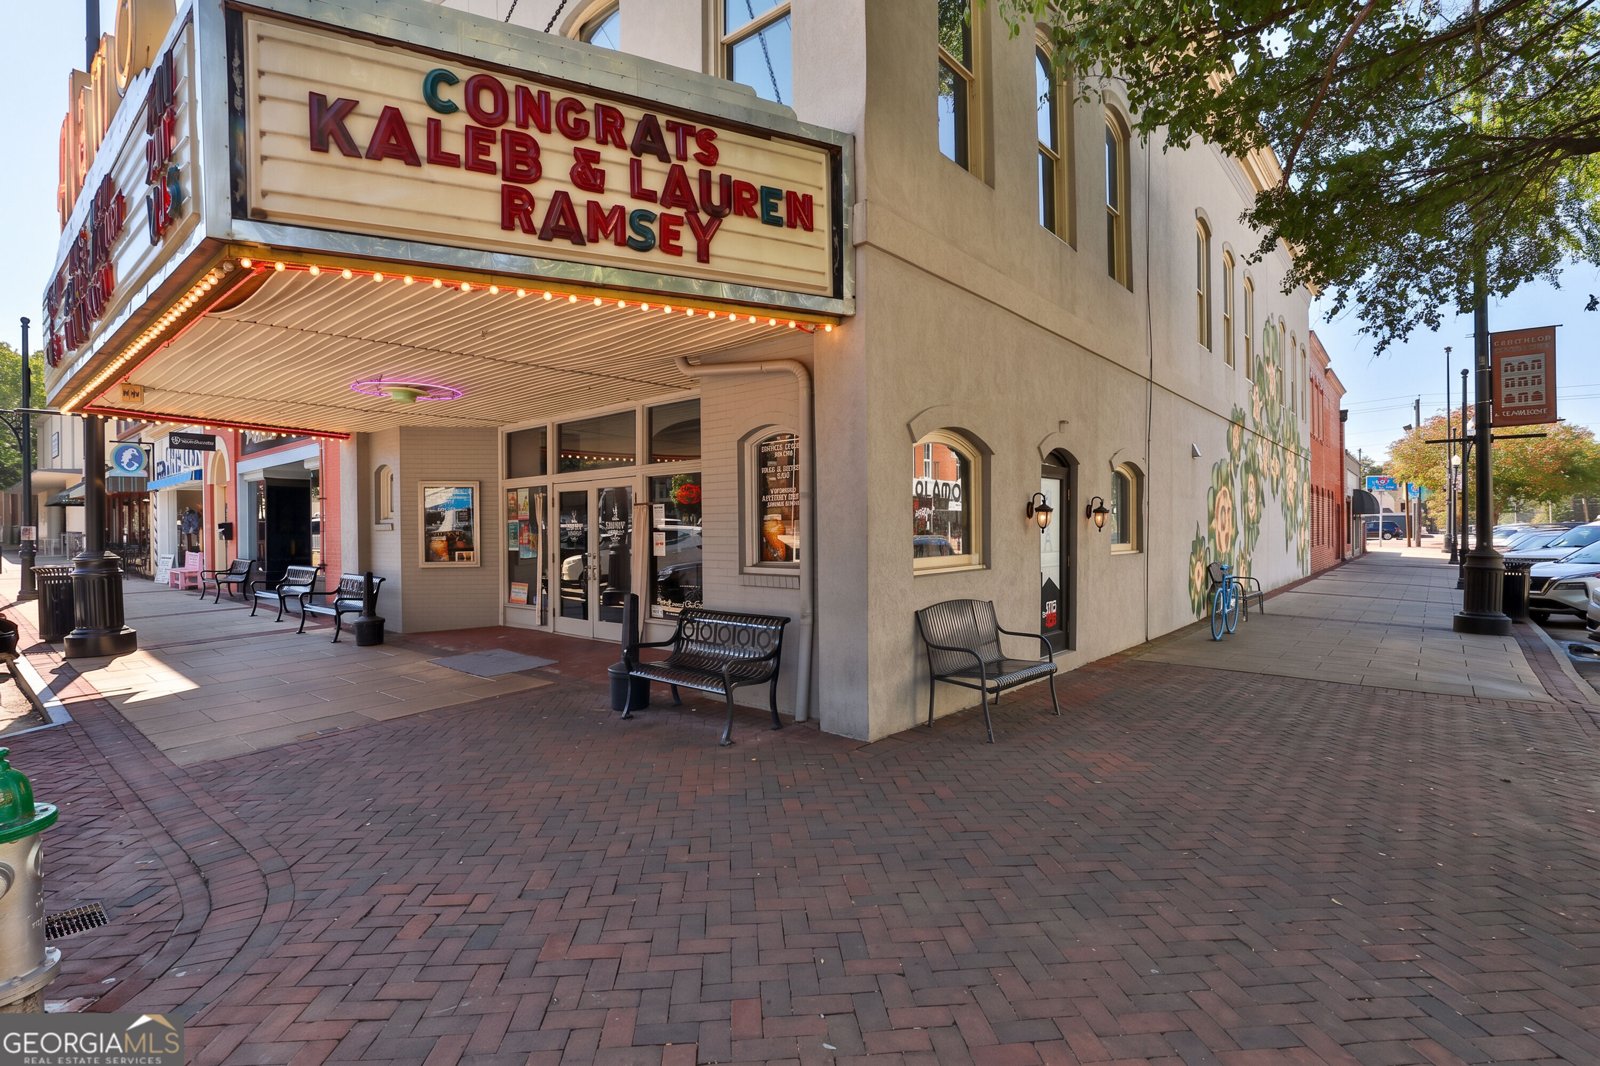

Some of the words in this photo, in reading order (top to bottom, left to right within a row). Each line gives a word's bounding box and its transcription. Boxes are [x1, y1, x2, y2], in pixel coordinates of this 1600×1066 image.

[308, 91, 542, 184] KALEB
[569, 146, 606, 194] &
[629, 157, 814, 232] LAUREN
[422, 68, 719, 167] CONGRATS
[501, 184, 724, 264] RAMSEY
